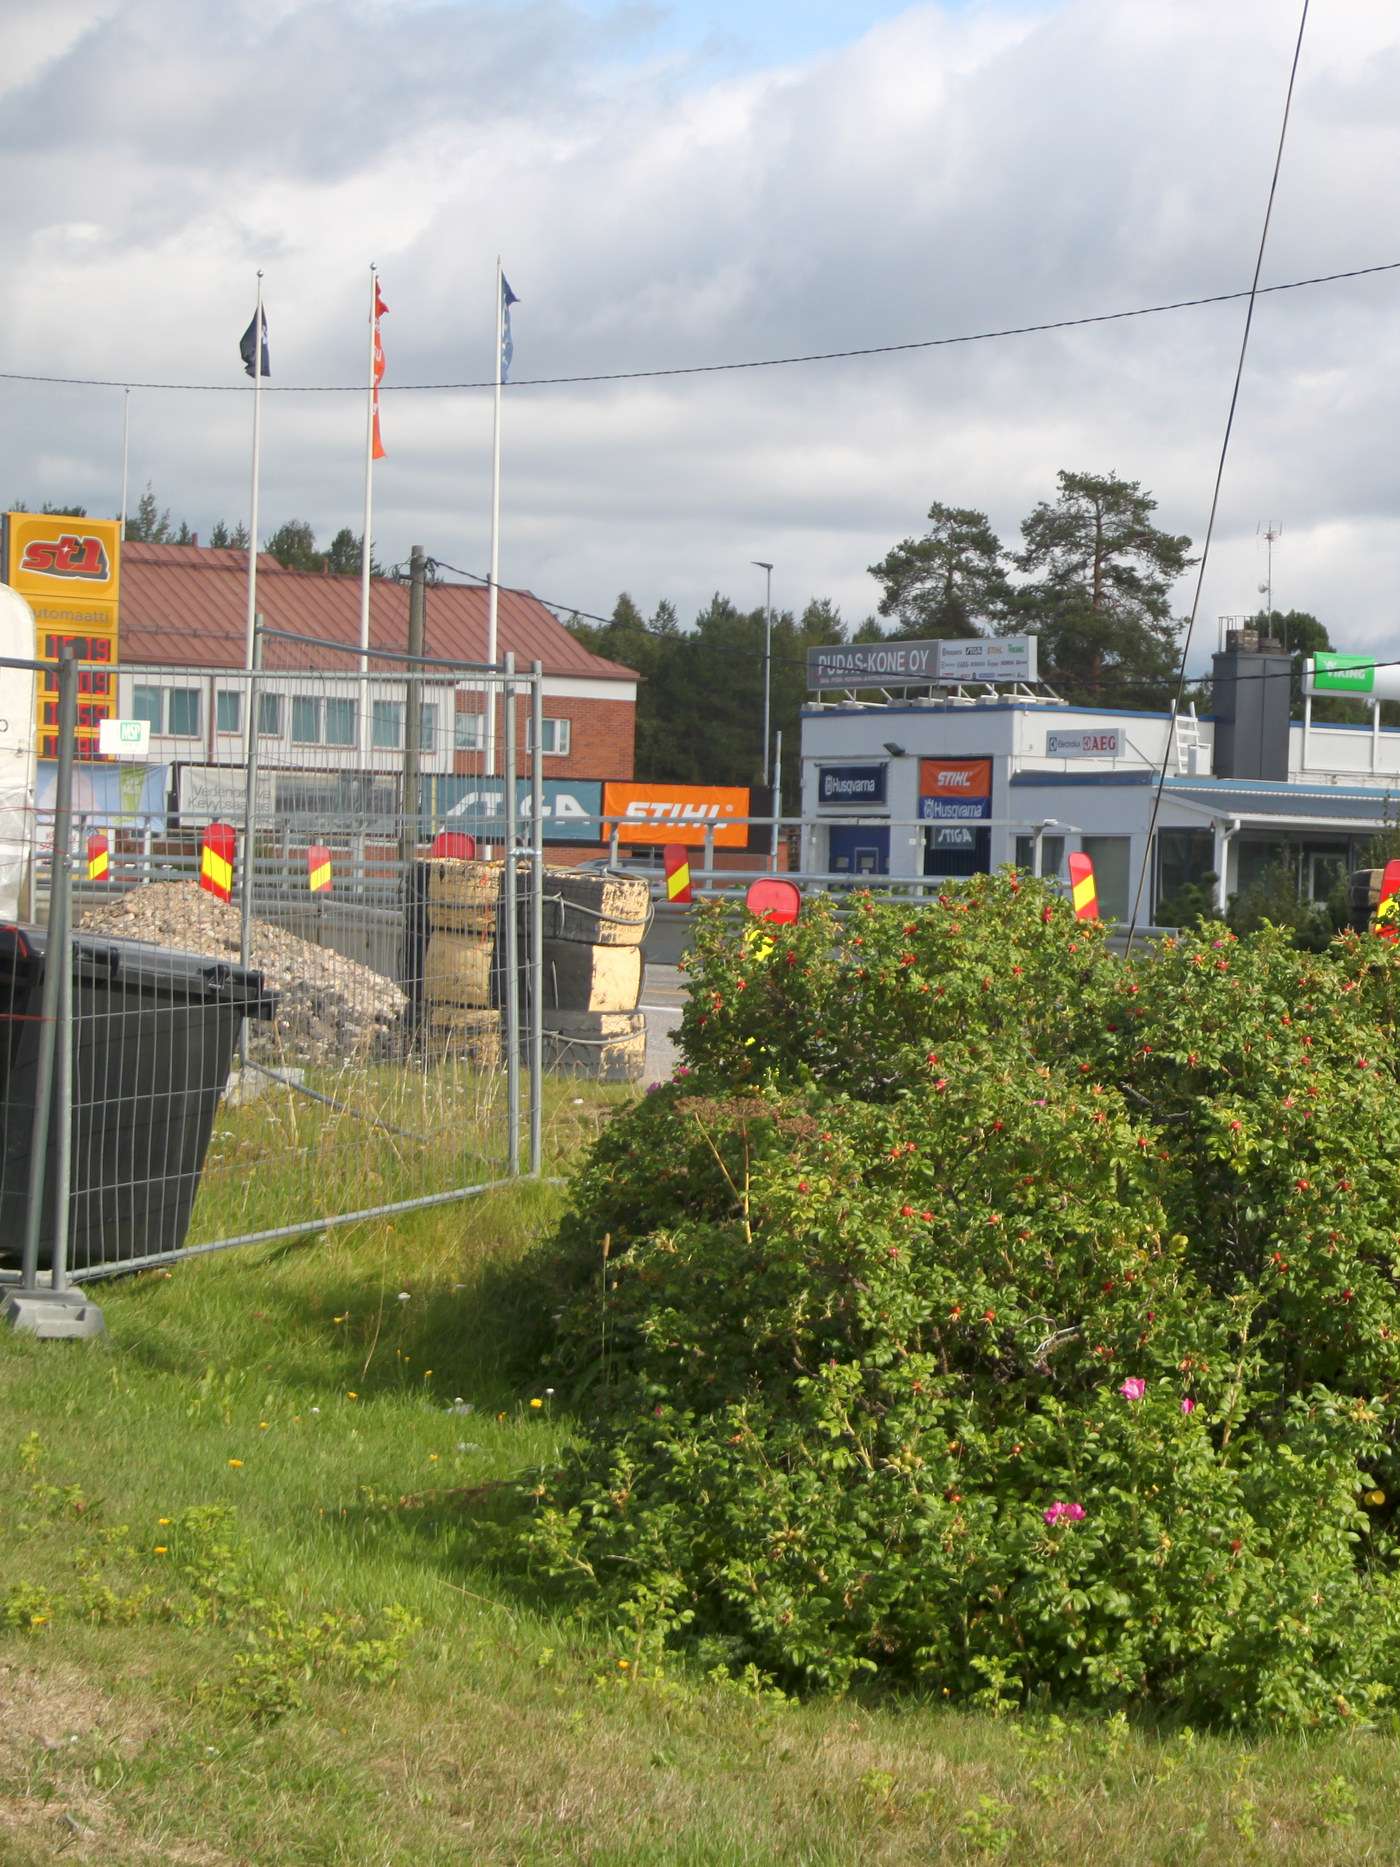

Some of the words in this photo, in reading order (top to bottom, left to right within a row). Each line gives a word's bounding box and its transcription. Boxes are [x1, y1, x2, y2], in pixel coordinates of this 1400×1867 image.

[21, 535, 107, 578] st1
[31, 608, 110, 623] utomaatti
[818, 650, 906, 676] PUDAS-KONE
[909, 649, 930, 671] OY
[51, 671, 108, 695] 109
[50, 702, 107, 728] 159
[121, 723, 140, 740] MSP
[1091, 735, 1117, 751] AEG
[832, 778, 876, 795] Husqvarna
[937, 771, 971, 787] STIHL
[439, 791, 590, 832] STGA
[621, 801, 728, 828] STIHL
[934, 803, 982, 819] Husqvarna
[937, 828, 972, 843] STIGA
